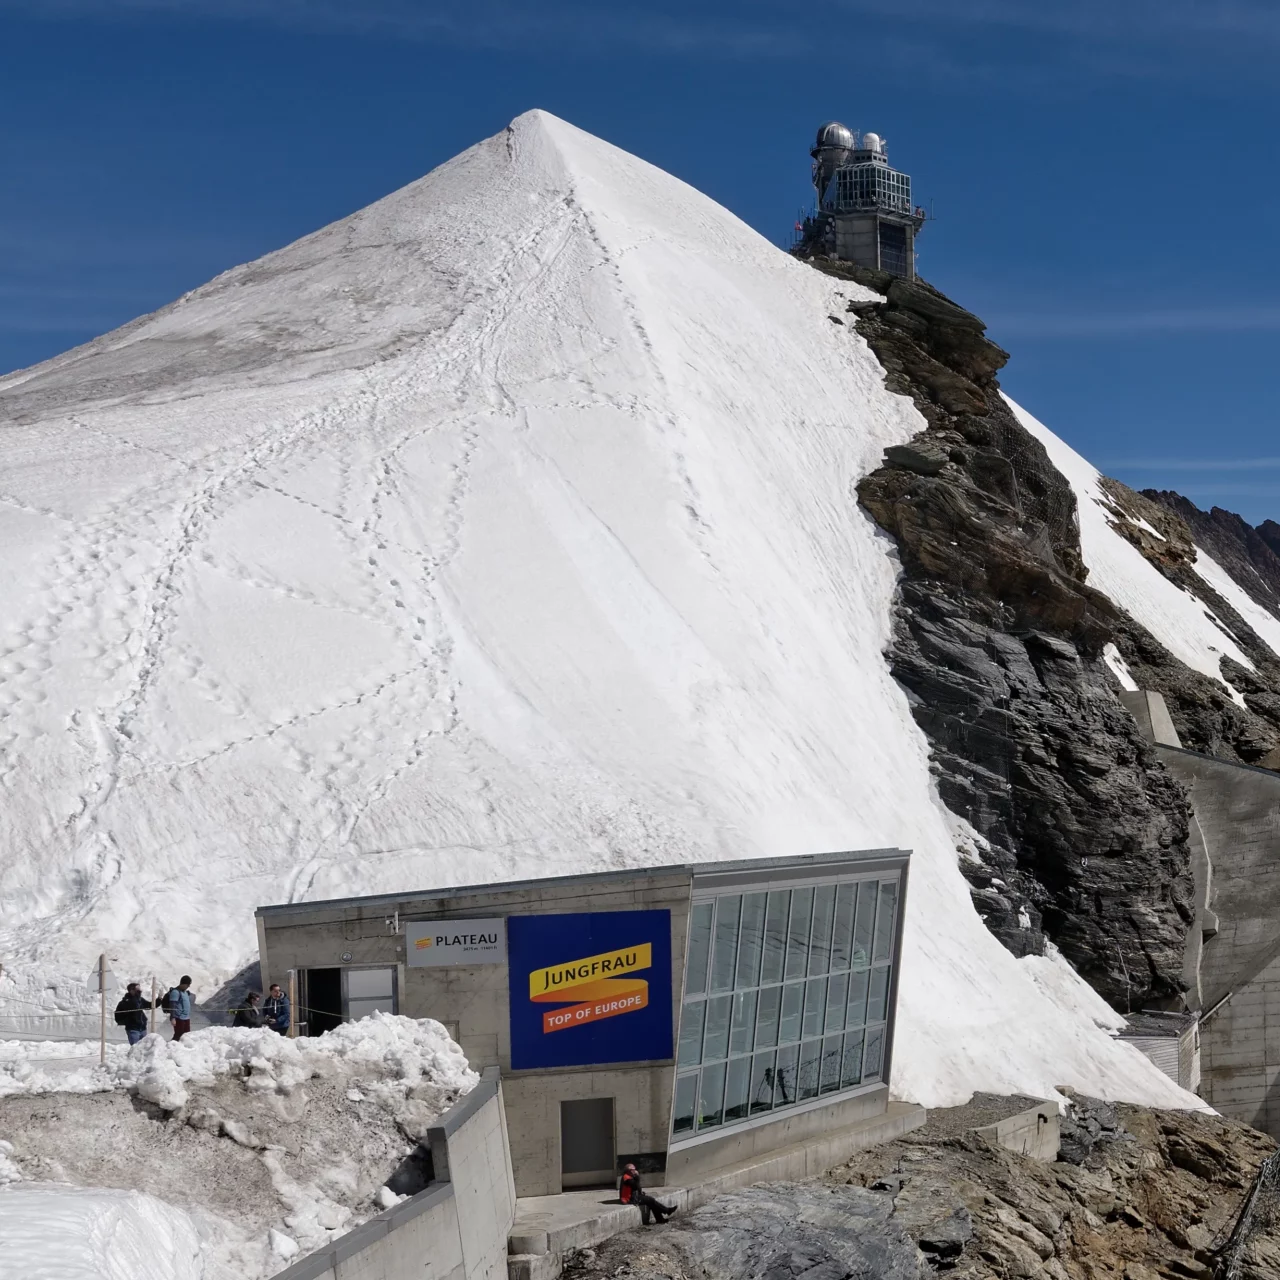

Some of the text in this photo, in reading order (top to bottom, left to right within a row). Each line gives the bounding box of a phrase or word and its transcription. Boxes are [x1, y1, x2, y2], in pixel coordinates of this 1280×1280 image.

[435, 933, 498, 946] PLATEAU
[544, 953, 637, 990] JUNGFRAU
[548, 995, 642, 1027] TOP OF EUROPE
